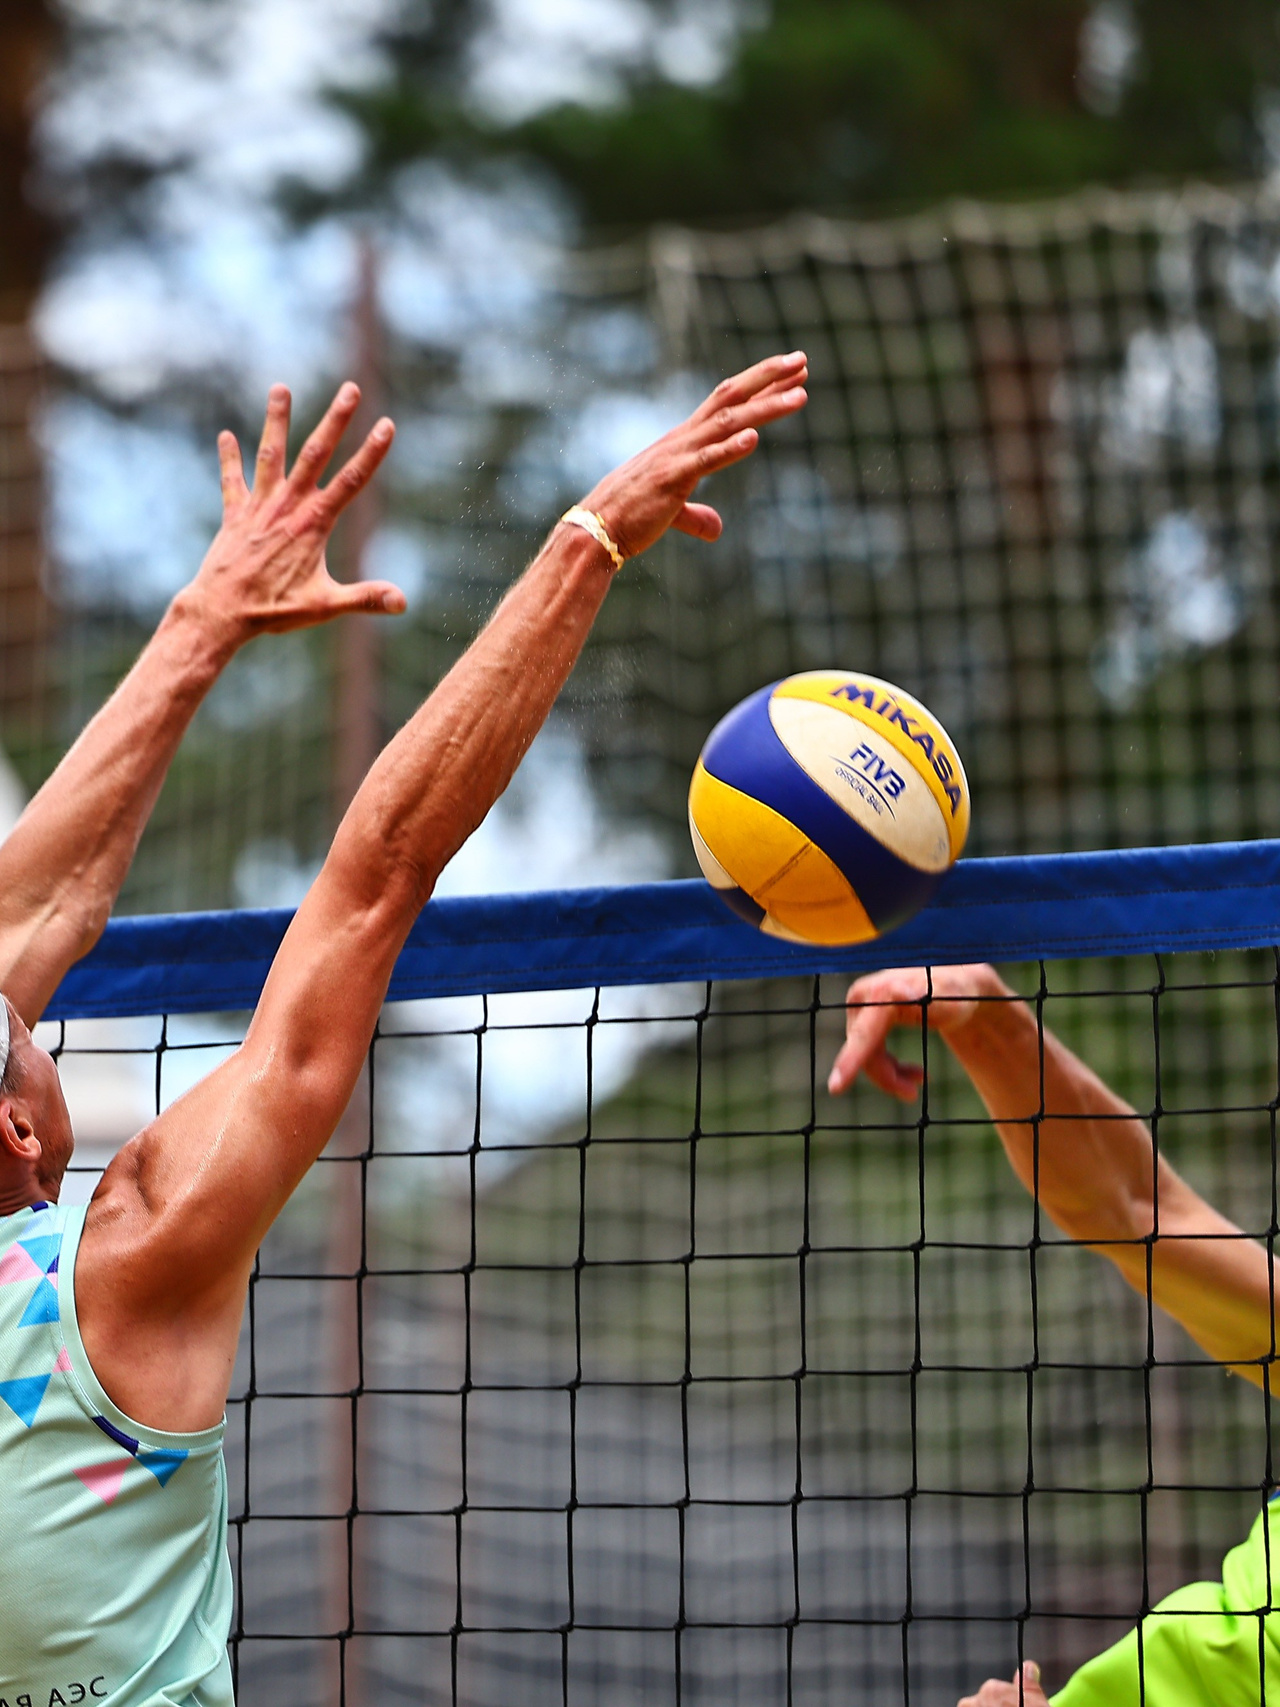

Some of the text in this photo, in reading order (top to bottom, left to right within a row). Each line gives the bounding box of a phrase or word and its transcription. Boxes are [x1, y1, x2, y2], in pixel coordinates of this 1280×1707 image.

[835, 766, 885, 816] OFFICIAL BALL
[48, 1675, 108, 1707] АЭС
